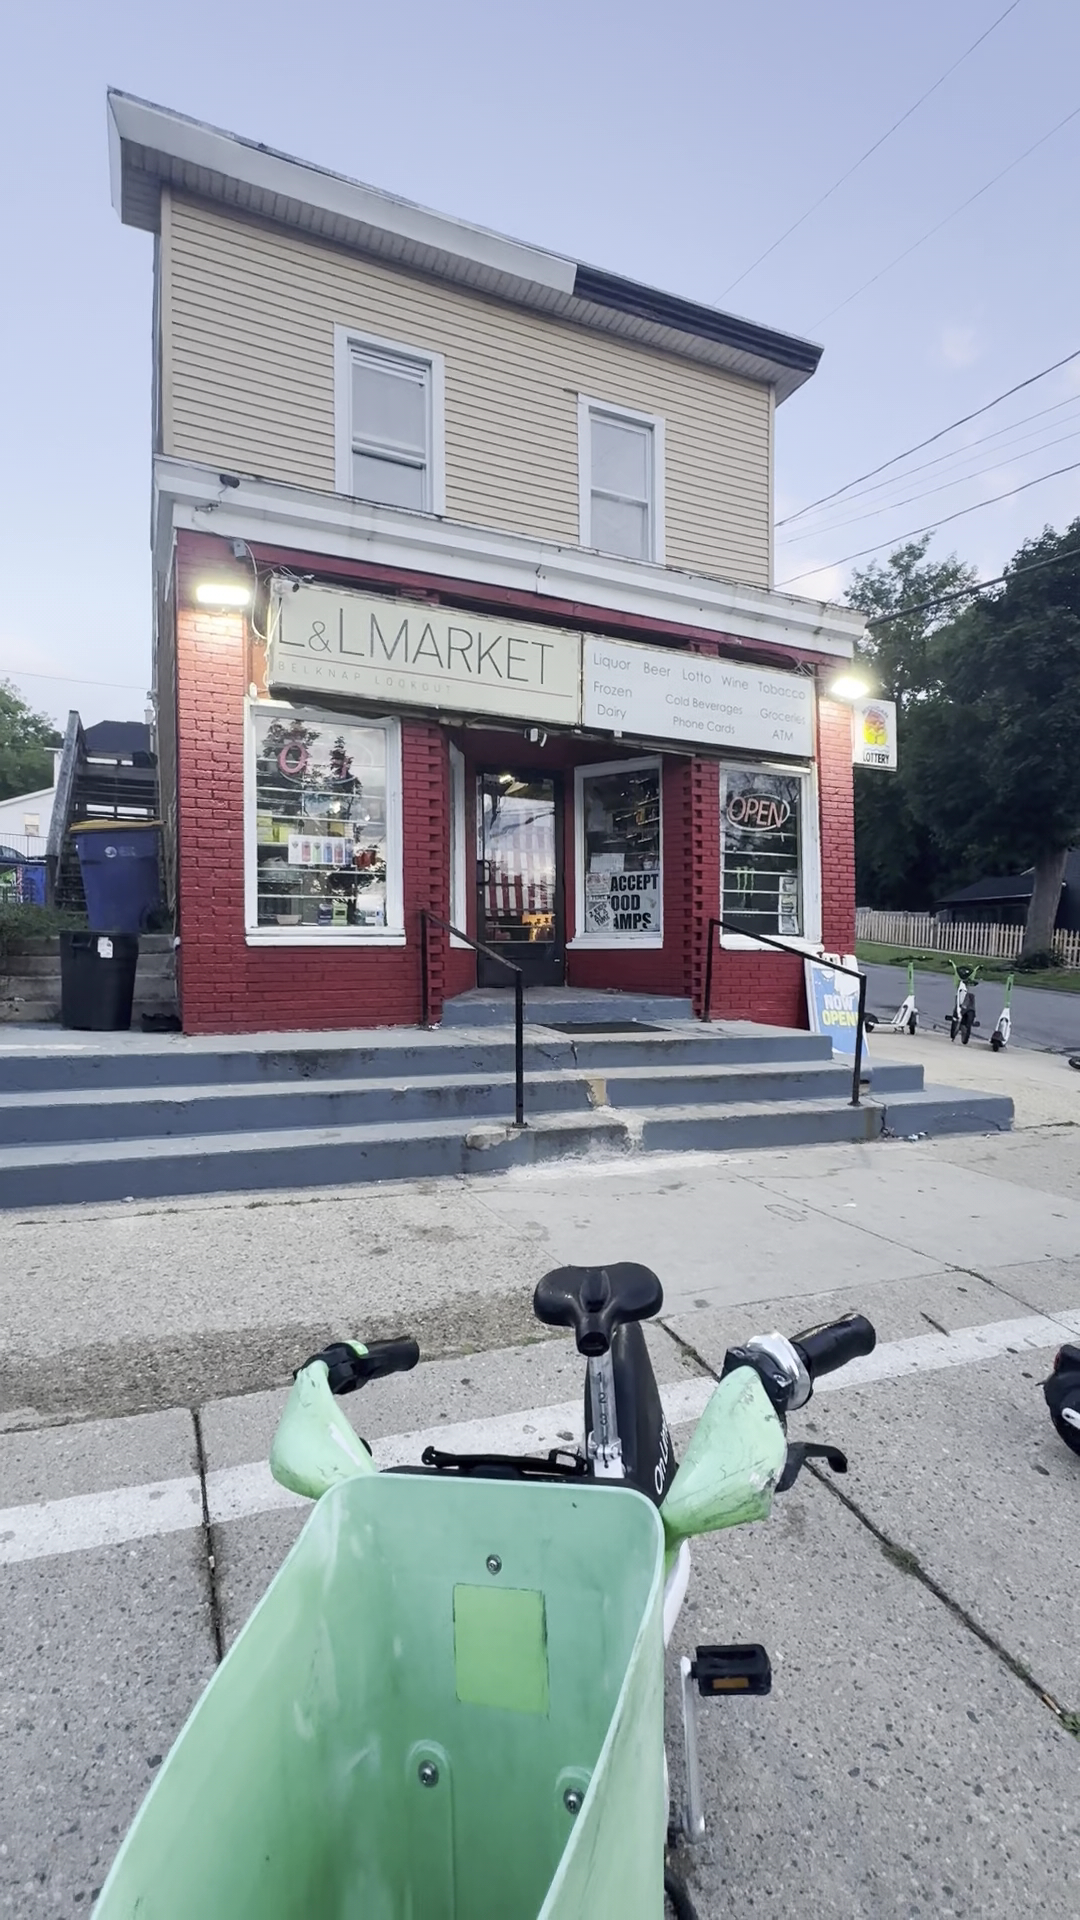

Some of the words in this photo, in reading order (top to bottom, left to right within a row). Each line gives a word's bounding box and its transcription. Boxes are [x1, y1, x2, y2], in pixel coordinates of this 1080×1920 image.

[369, 612, 554, 685] MARKET
[278, 661, 361, 681] BELKNAP
[374, 675, 452, 695] LOOKOUT
[593, 653, 631, 672] Liquor
[643, 661, 671, 679] Beer
[682, 668, 712, 685] Lotto
[721, 675, 749, 691] Wine
[758, 681, 806, 700] Tobacco
[593, 681, 633, 699] Frozen
[597, 703, 627, 720] Dairy
[665, 693, 690, 707] Cold
[692, 697, 743, 717] Beverages
[672, 716, 705, 732] Phone
[706, 719, 736, 735] Cards
[759, 707, 806, 726] Groceries
[771, 729, 794, 742] ATM
[863, 751, 890, 765] LOTTERY
[728, 796, 785, 828] OPEN
[610, 873, 659, 892] ACCEPT
[607, 894, 641, 911] OOD
[613, 912, 652, 930] AMPS
[823, 993, 855, 1011] NOW
[597, 1371, 602, 1382] 1
[599, 1392, 607, 1403] 2
[600, 1413, 607, 1425] 3
